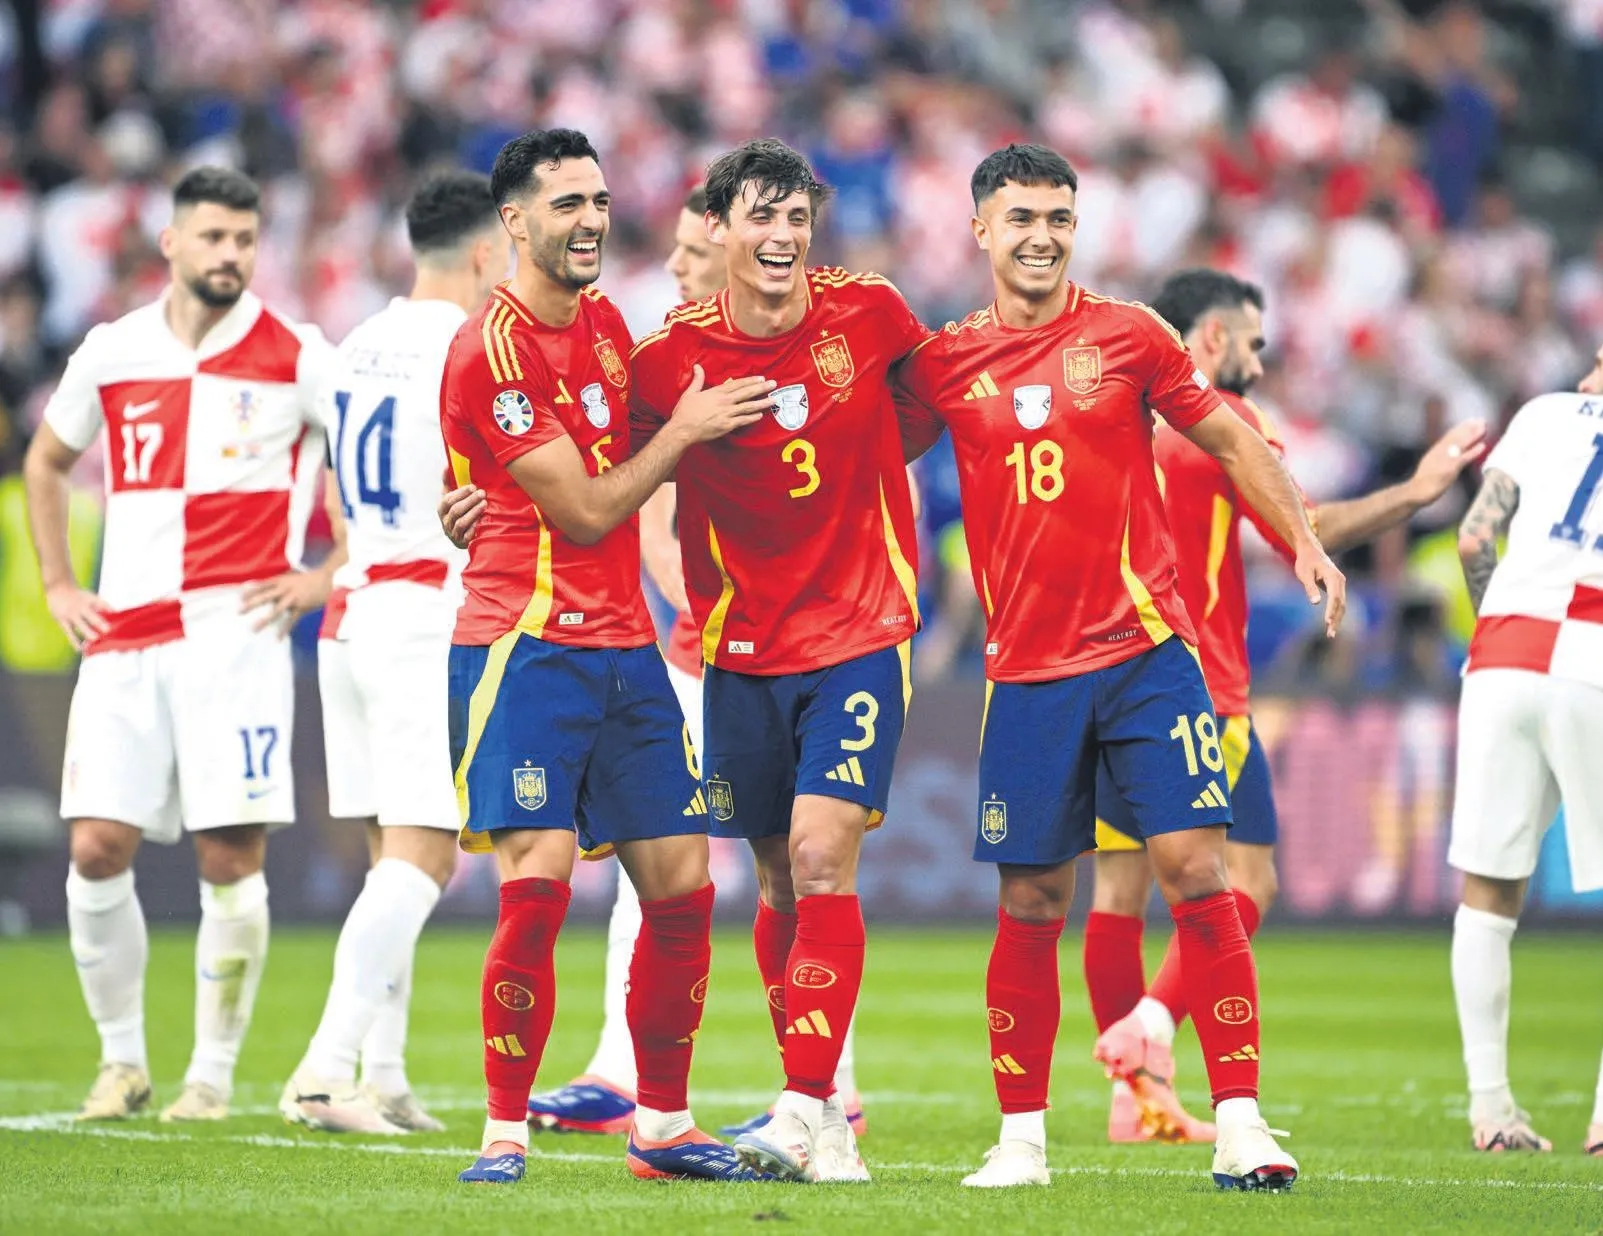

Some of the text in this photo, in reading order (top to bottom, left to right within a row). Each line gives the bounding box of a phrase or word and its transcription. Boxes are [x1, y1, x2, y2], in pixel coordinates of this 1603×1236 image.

[121, 422, 163, 482] 17
[334, 390, 405, 525] 14
[781, 438, 821, 499] 3
[1005, 439, 1065, 505] 18
[841, 692, 879, 751] 3
[1171, 713, 1223, 776] 18
[240, 726, 277, 780] 17
